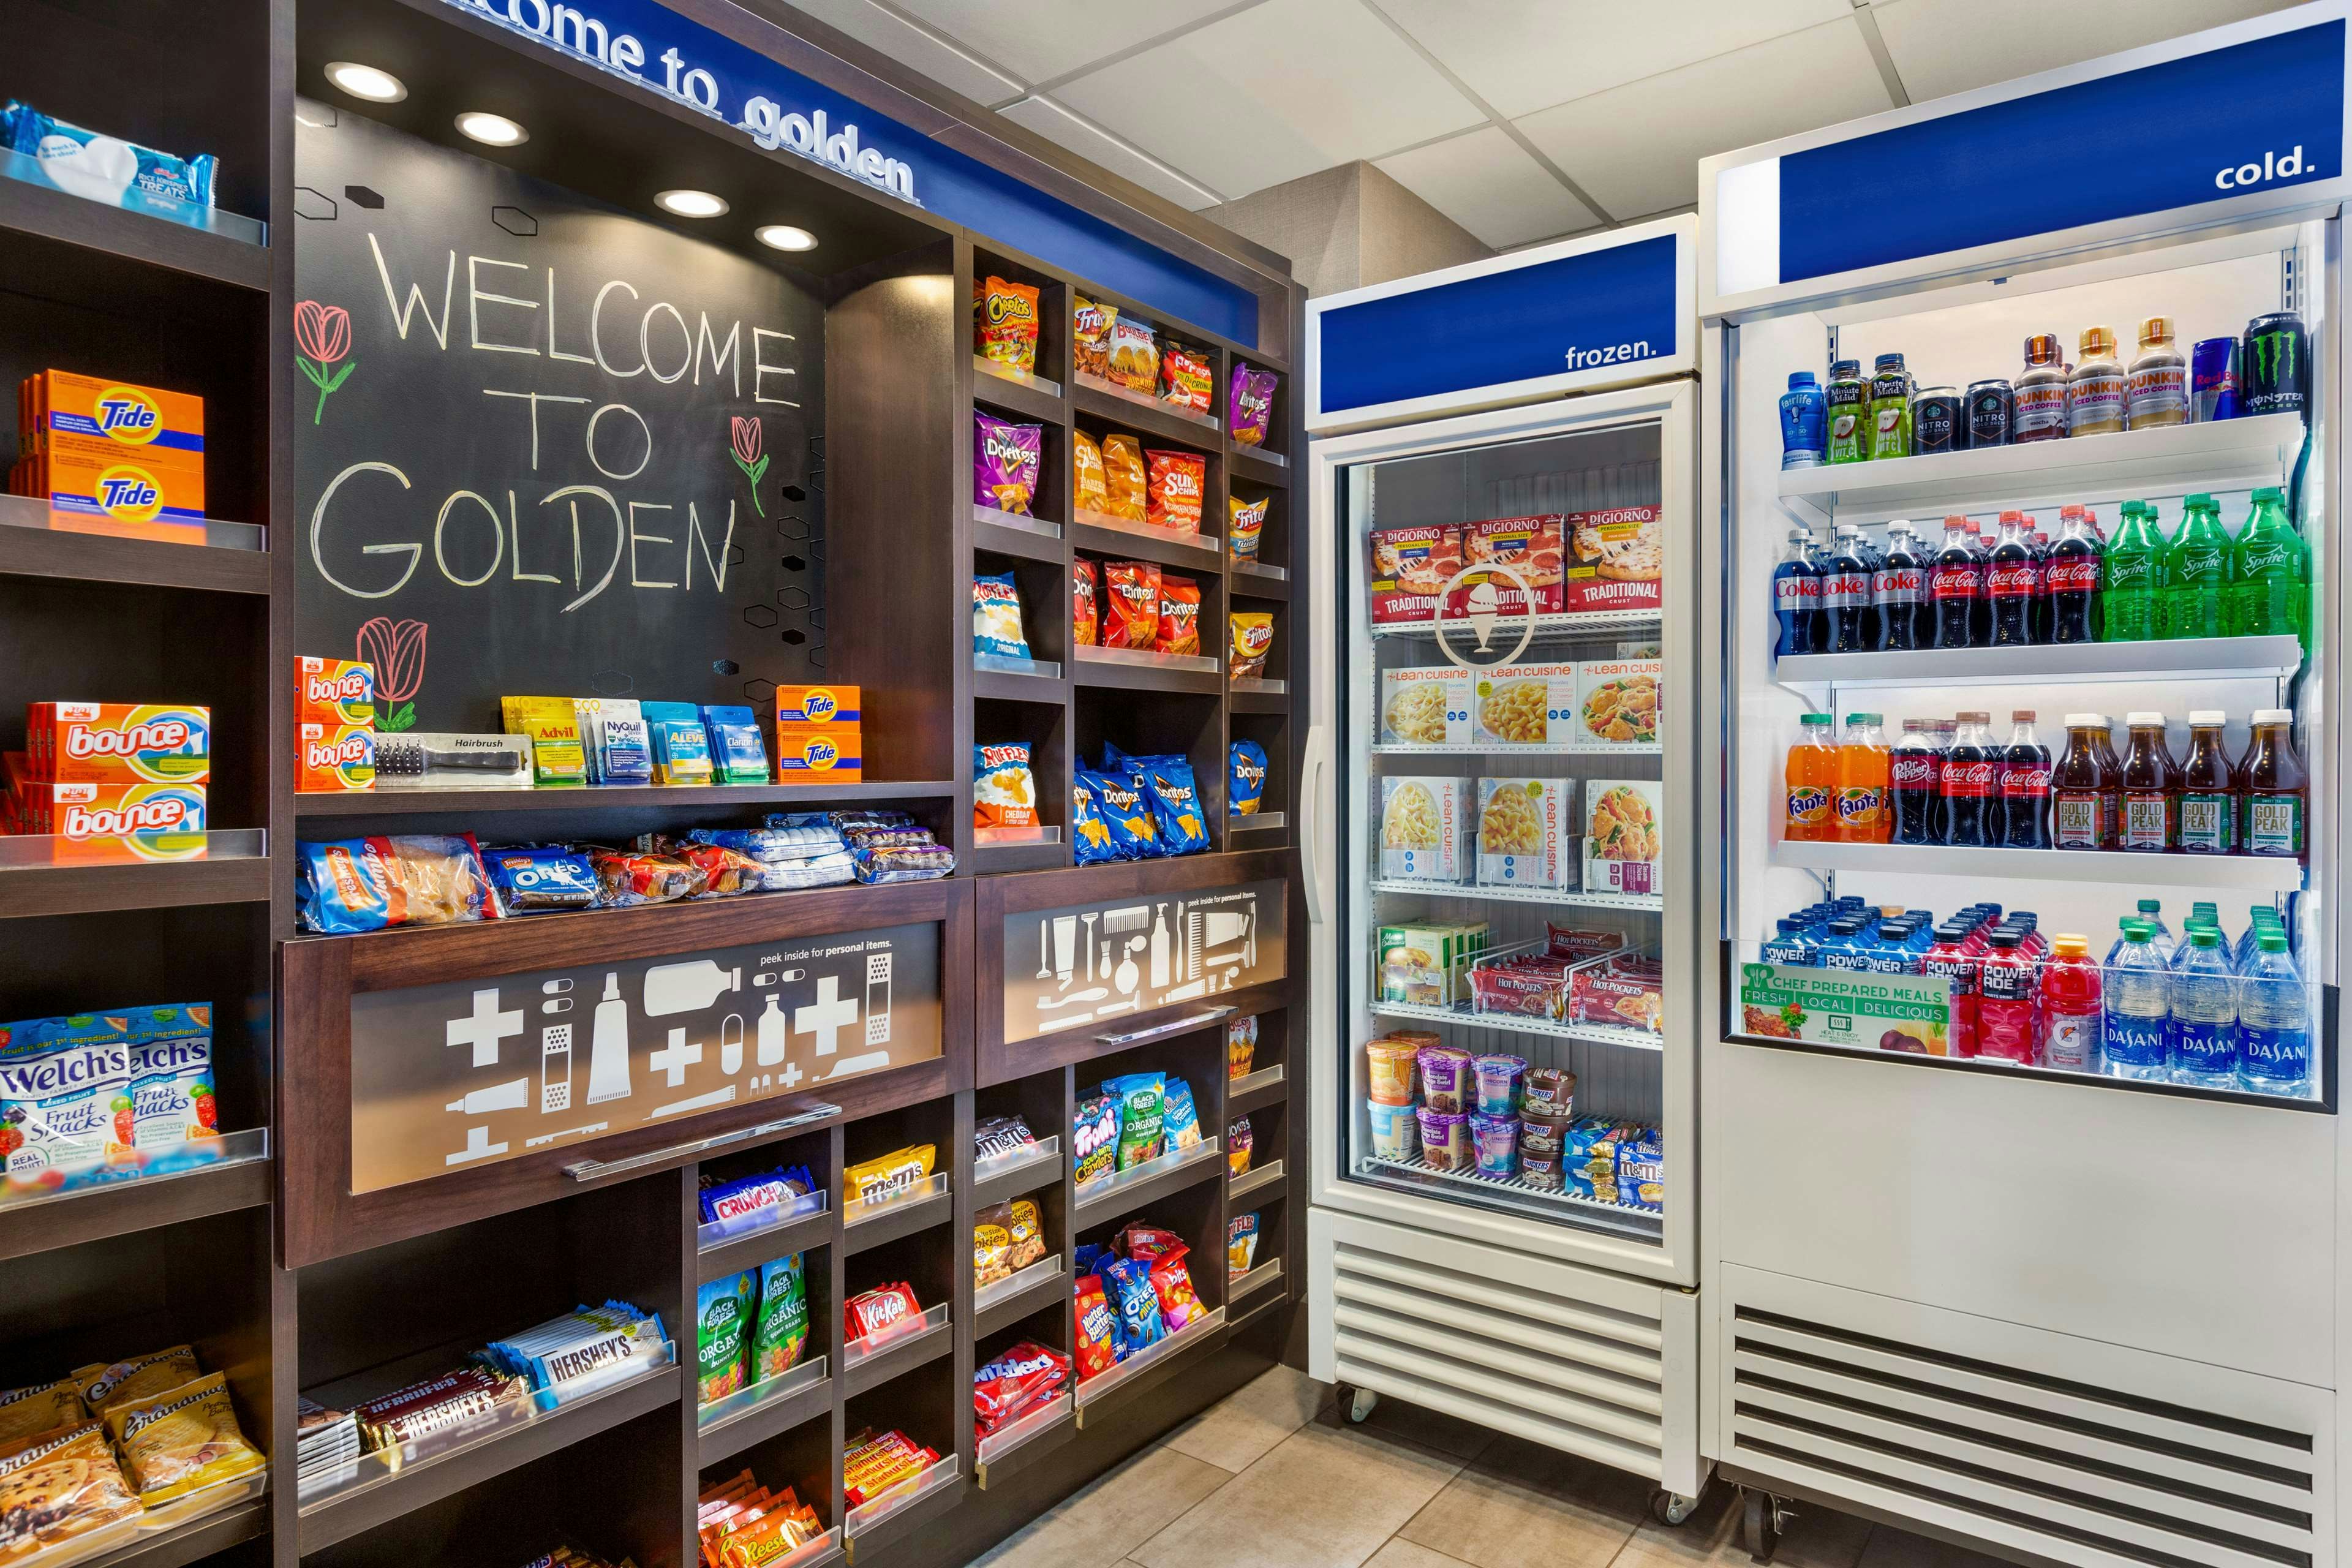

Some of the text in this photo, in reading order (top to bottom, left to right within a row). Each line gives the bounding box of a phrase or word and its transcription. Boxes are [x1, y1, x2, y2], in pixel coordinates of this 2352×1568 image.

[441, 0, 914, 197] come to golden
[2215, 145, 2315, 189] cold.
[138, 173, 188, 191] RICE KRISPIES
[140, 180, 185, 200] TREATS
[987, 294, 1031, 322] Cheetos
[368, 233, 800, 408] WELCOME
[1565, 341, 1656, 369] frozen.
[1874, 380, 1904, 390] Minute
[2196, 372, 2221, 385] Red
[1877, 387, 1900, 396] Maid
[2091, 394, 2119, 404] COFFEE
[2133, 385, 2180, 396] ICED COFFEE
[1781, 394, 1812, 409] fairlife
[2019, 404, 2033, 413] ICED
[2245, 393, 2304, 407] MONSTER
[2252, 402, 2299, 412] ENERGY
[100, 399, 156, 431] Tide
[1973, 413, 2005, 423] NITRO
[483, 389, 652, 480] TO
[1918, 421, 1950, 431] NITRO
[987, 438, 1036, 464] Doritos
[1165, 473, 1198, 496] SUN
[102, 479, 157, 508] Tide
[311, 462, 735, 613] GOLDEN
[2185, 558, 2220, 572] Sprite
[2247, 552, 2285, 568] Sprite
[1932, 565, 1978, 589] Coca-Cola
[1988, 564, 2037, 587] Coca-Cola
[2046, 558, 2098, 583] Coca-Cola
[2114, 565, 2147, 580] Sprite
[1776, 578, 1820, 598] Coke
[1822, 577, 1863, 596] Coke
[1874, 572, 1919, 591] Coke
[1121, 584, 1155, 600] Doritos
[1583, 583, 1658, 602] TRADITIONAL
[1161, 600, 1199, 616] Doritos
[997, 644, 1020, 655] ORIGINAL
[1396, 671, 1423, 680] Lean
[1594, 663, 1627, 674] Lean
[309, 675, 364, 703] bounce
[805, 696, 834, 717] Tide
[539, 726, 574, 738] Advil
[607, 722, 641, 733] NyQuil
[68, 722, 187, 758] bounce
[455, 739, 503, 748] Hairbrush
[669, 733, 706, 743] ALEVE
[727, 737, 753, 747] Claritin
[309, 741, 366, 769] bounce
[807, 745, 835, 765] Tide
[982, 747, 1029, 767] RUFFLES
[1236, 765, 1264, 778] Doritos
[1893, 763, 1926, 780] Pepper
[1904, 761, 1917, 771] Dr
[1942, 764, 1992, 783] Coca-Cola
[2000, 769, 2051, 786] Coca-Cola
[1102, 789, 1140, 804] Doritos
[1155, 786, 1191, 799] Doritos
[1443, 793, 1453, 826] Lean
[1547, 797, 1556, 829] Lean
[1789, 794, 1828, 815] Fanta
[1838, 794, 1878, 815] Fanta
[2062, 804, 2090, 815] GOLD
[2132, 804, 2162, 815] GOLD
[2185, 804, 2215, 815] GOLD
[2255, 806, 2288, 818] GOLD
[66, 800, 184, 836] bounce
[2062, 815, 2090, 826] PEAK
[2132, 816, 2162, 827] PEAK
[2185, 816, 2215, 827] PEAK
[2255, 819, 2289, 831] PEAK
[1188, 899, 1199, 907] peek
[1221, 893, 1242, 903] personal
[1569, 937, 1599, 946] POCKETS
[761, 940, 892, 966] peek inside for personal items.
[1765, 947, 1805, 961] POWER
[1927, 961, 1972, 974] POWER
[1983, 966, 2033, 979] POWER
[1513, 981, 1542, 992] POCKETS
[1593, 980, 1642, 995] HOT POCKETS
[1773, 978, 1942, 1002] CHEF PREPARED MEALS
[1983, 978, 2014, 990] ADE
[1745, 990, 1943, 1020] FRESH LOCAL DELICIOUS
[154, 1028, 201, 1038] Ingredient!
[2053, 1021, 2081, 1048] G
[2109, 1028, 2162, 1048] DASANI
[2, 1047, 24, 1055] Fruit
[70, 1033, 119, 1044] Ingredient!
[2249, 1042, 2305, 1063] DASANI
[1, 1049, 126, 1093] Welch's
[69, 1091, 91, 1100] FRUIT
[1133, 1095, 1154, 1105] BLACK
[1528, 1087, 1553, 1098] SNICKERS
[46, 1102, 96, 1124] Fruit
[1133, 1101, 1155, 1110] FOREST
[30, 1114, 107, 1141] Snacks
[1127, 1116, 1163, 1131] ORGANIC
[1525, 1123, 1551, 1134] SNICKERS
[1075, 1108, 1117, 1157] Trolli
[12, 1153, 39, 1166] REAL
[1076, 1152, 1113, 1182] Crawlers
[1524, 1159, 1550, 1169] SNICKERS
[861, 1164, 924, 1206] m&m's
[718, 1184, 776, 1219] CRUNCH
[1169, 1268, 1186, 1286] bits
[769, 1283, 791, 1302] FOREST
[1125, 1285, 1155, 1316] OREO
[709, 1300, 734, 1319] BLACK
[867, 1297, 905, 1330] KitKat
[1082, 1304, 1104, 1329] Nutter
[707, 1308, 736, 1330] FOREST
[785, 1318, 801, 1330] BEARS
[1088, 1313, 1110, 1343] Butter
[551, 1335, 632, 1382] HERSHEY'S
[407, 1390, 494, 1439] HERSHEY'S
